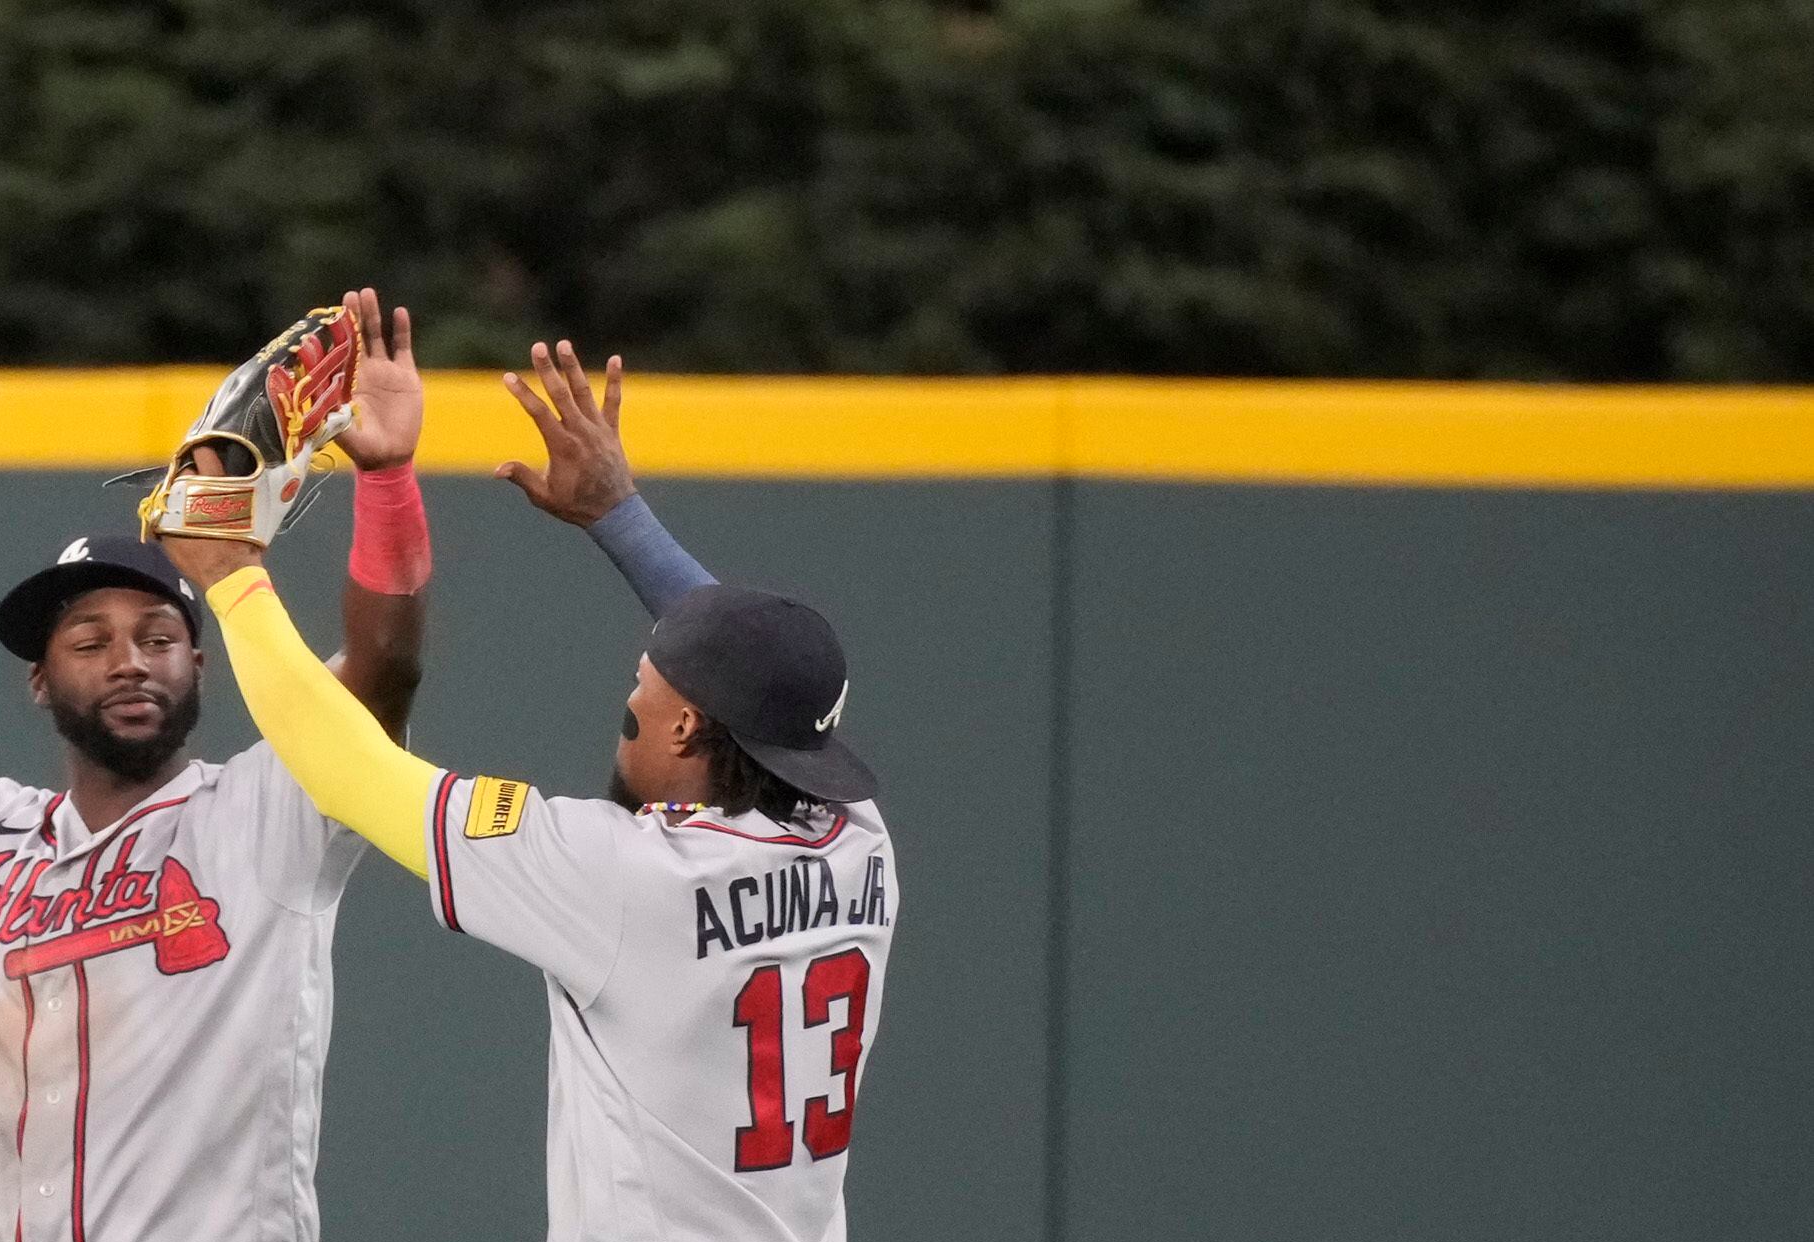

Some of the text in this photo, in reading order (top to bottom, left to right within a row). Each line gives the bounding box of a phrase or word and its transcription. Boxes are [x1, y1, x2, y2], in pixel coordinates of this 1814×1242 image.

[490, 782, 518, 832] QUIKRETE
[847, 855, 890, 928] JR.
[732, 946, 871, 1173] 13
